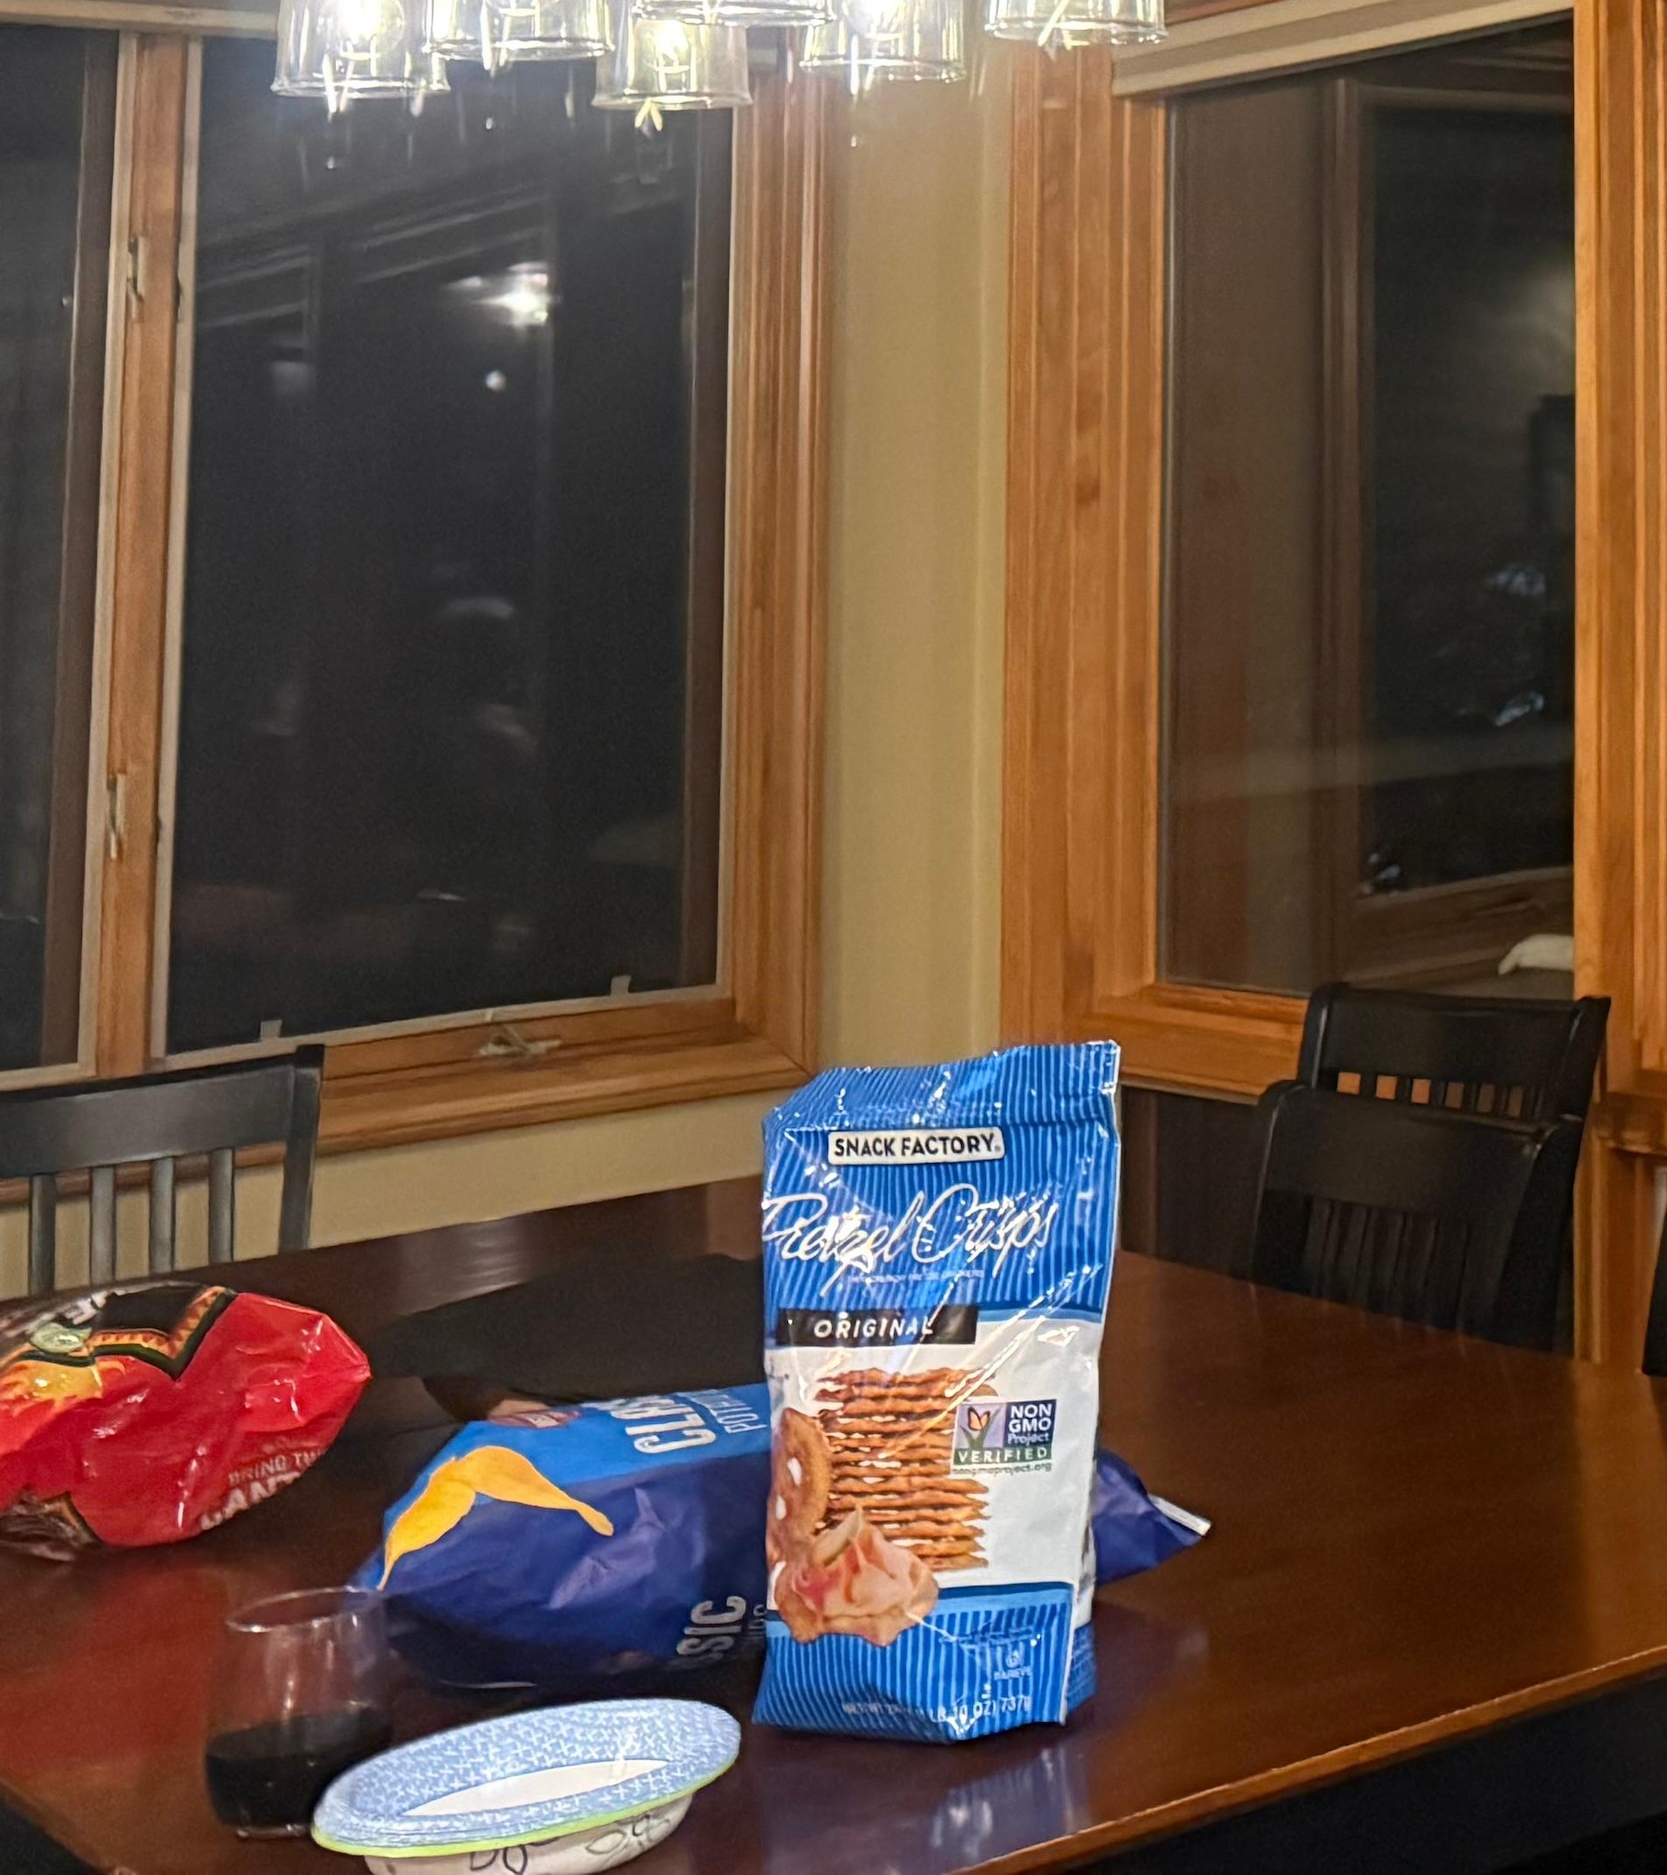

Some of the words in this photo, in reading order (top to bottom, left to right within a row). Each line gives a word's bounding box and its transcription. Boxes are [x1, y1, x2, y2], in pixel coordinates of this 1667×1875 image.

[833, 1136, 896, 1158] SNACK
[901, 1133, 995, 1157] FACTORY
[761, 1191, 926, 1297] Pretzel
[911, 1183, 1059, 1279] Crisps
[813, 1315, 934, 1340] ORIGINAL
[1010, 1403, 1052, 1419] NON
[1008, 1417, 1052, 1434] GMO
[1007, 1433, 1050, 1446] Project
[957, 1447, 1047, 1463] VERIFIED
